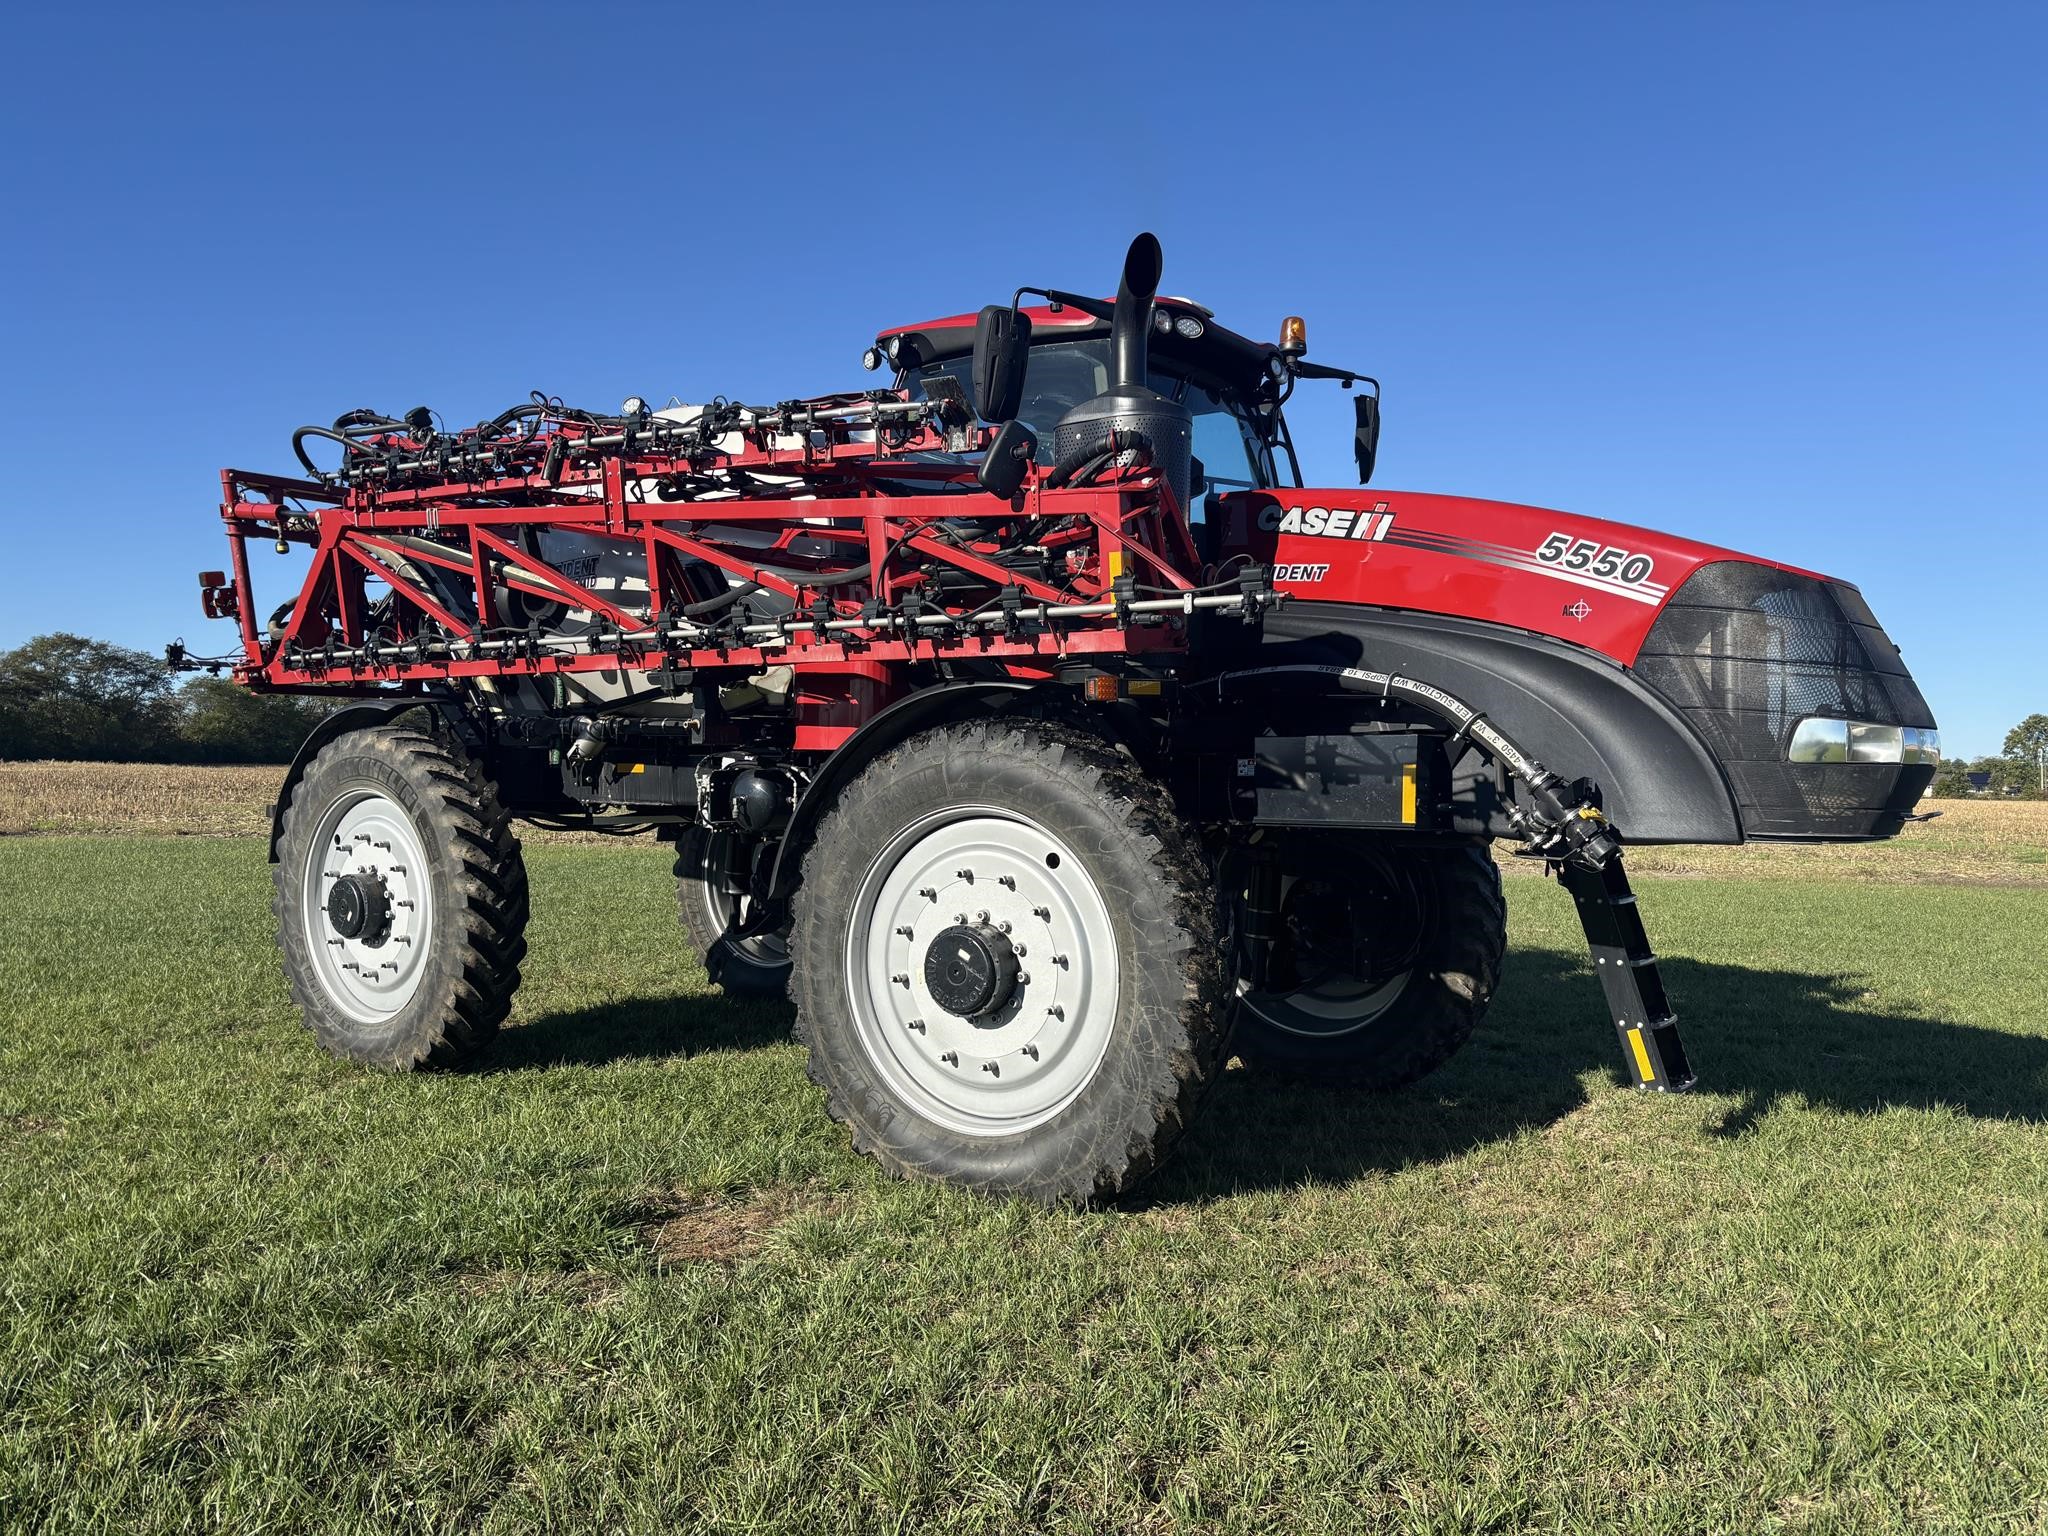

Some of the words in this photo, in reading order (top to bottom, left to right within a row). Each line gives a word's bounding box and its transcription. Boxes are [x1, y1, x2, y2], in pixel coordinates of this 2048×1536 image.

[1257, 504, 1355, 538] CASE
[1350, 502, 1395, 541] IH
[1536, 532, 1654, 586] 5550
[1272, 564, 1329, 581] IDENT
[1362, 672, 1389, 683] 50PSI
[1393, 677, 1408, 687] WP
[1412, 682, 1455, 707] SUCTION
[1501, 743, 1521, 763] 4450
